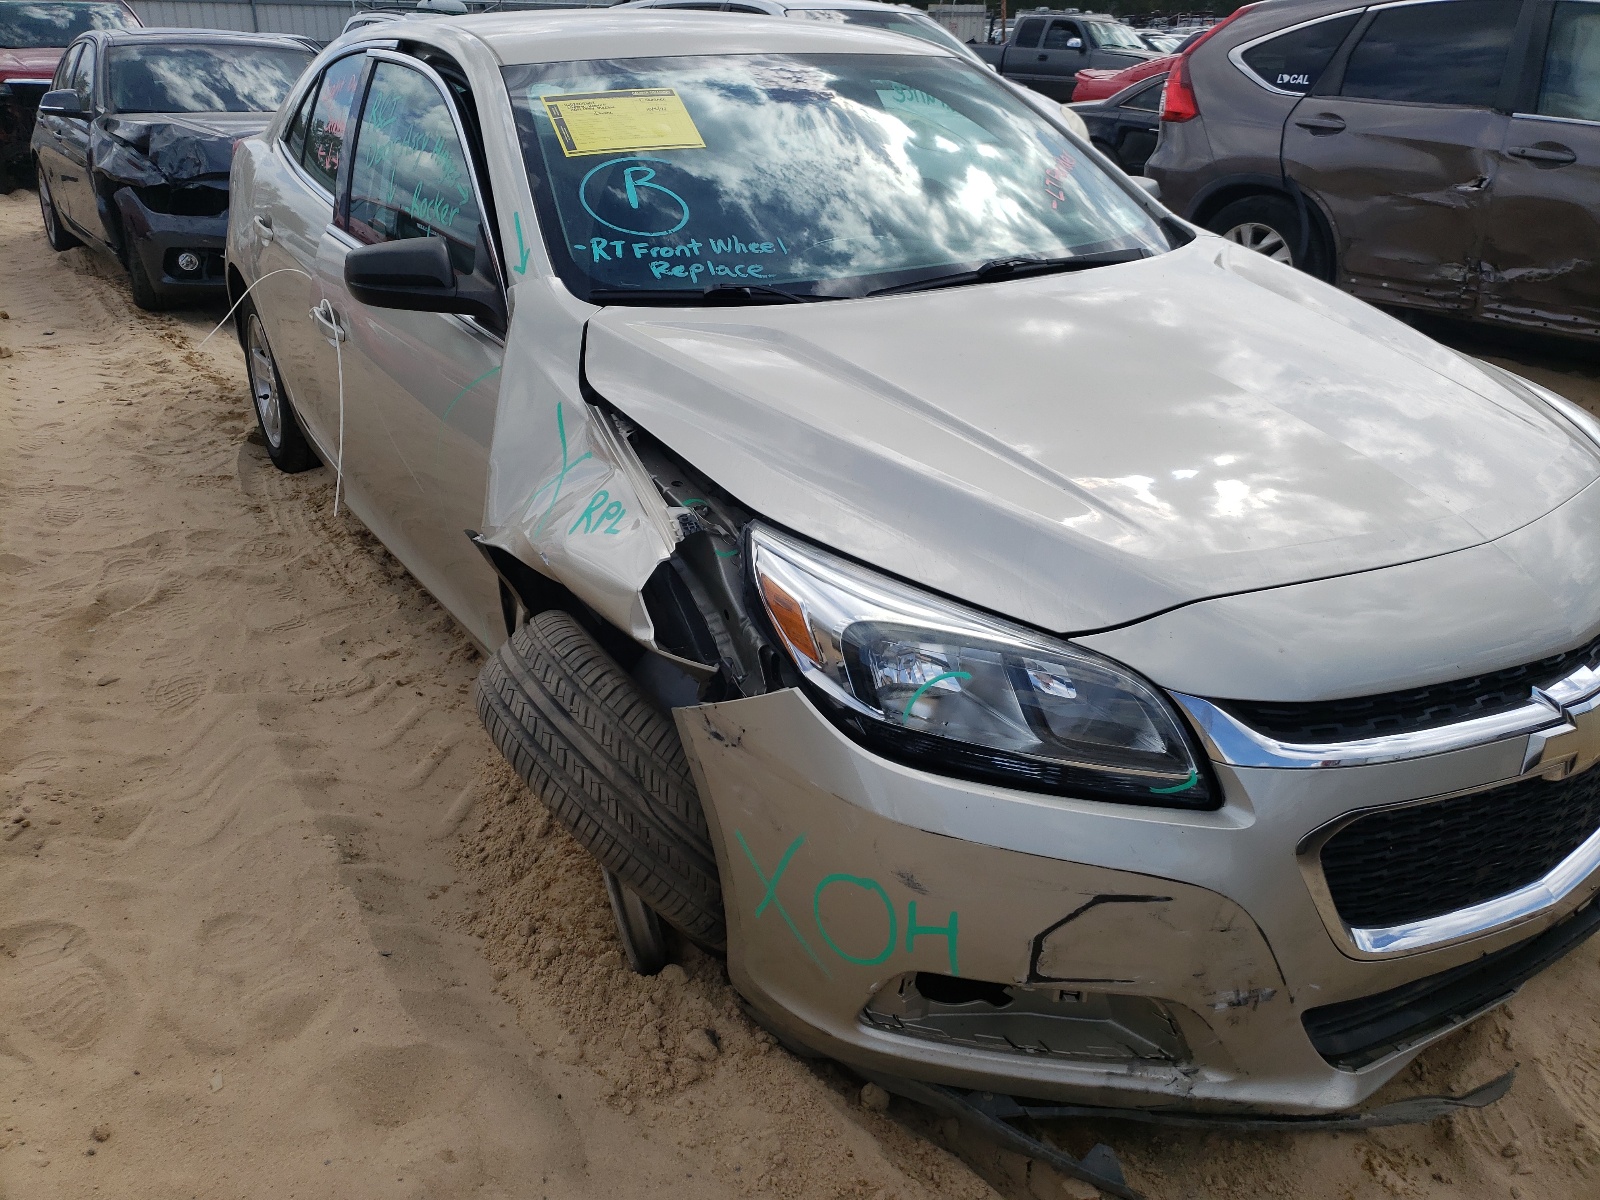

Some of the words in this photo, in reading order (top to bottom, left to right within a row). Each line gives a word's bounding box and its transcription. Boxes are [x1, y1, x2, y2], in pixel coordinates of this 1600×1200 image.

[632, 238, 703, 260] Front
[709, 234, 789, 256] Wheel
[648, 259, 770, 284] Replace
[567, 489, 627, 536] RPL
